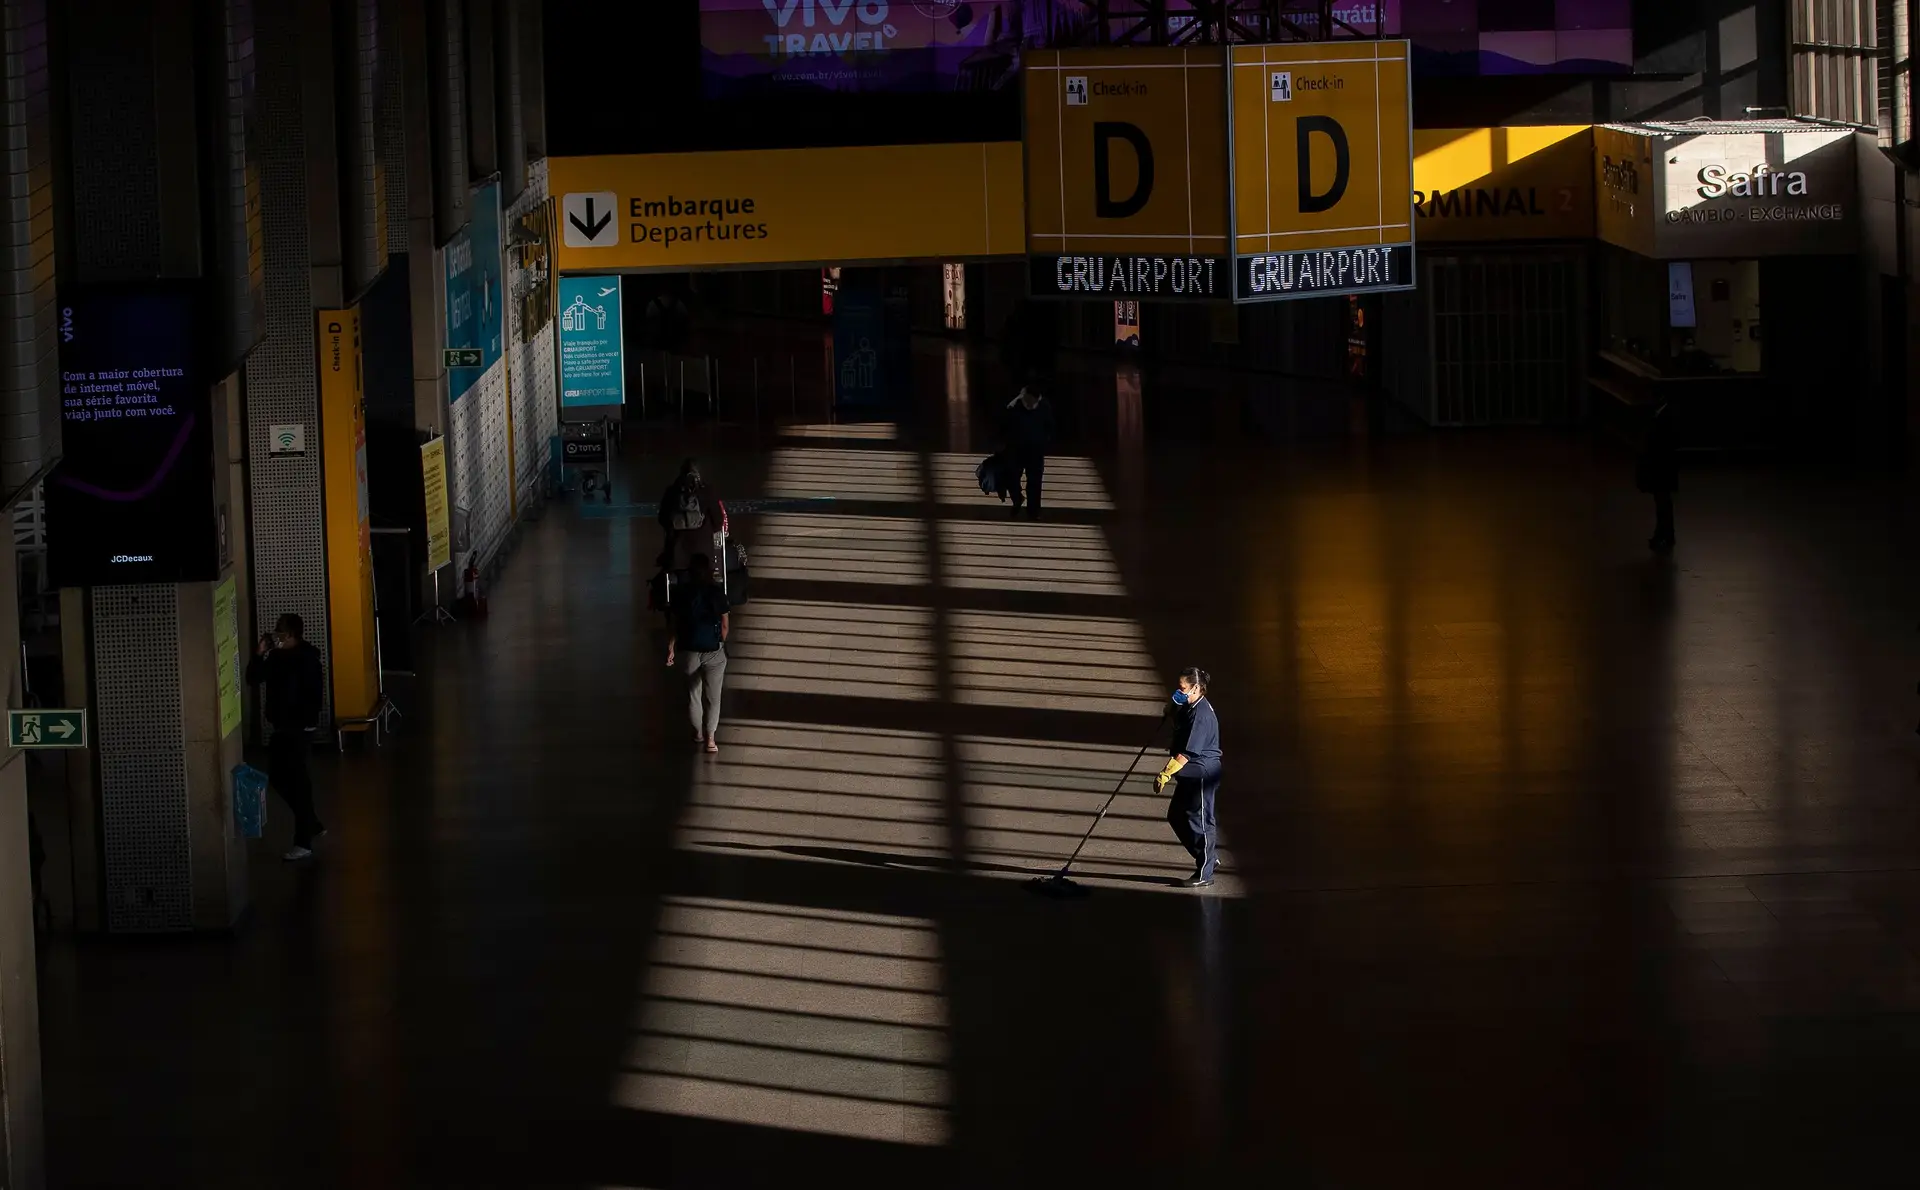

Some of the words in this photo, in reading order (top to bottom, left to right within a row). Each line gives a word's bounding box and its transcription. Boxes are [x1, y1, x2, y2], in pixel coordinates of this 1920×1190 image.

[763, 31, 890, 58] TRAVEL
[1093, 80, 1148, 96] Check-in
[1296, 74, 1344, 91] Check-in
[1094, 121, 1154, 218] D
[1296, 115, 1350, 214] D
[1698, 163, 1808, 199] Safra
[630, 196, 755, 221] Embarque
[1558, 189, 1574, 211] 2
[1750, 204, 1844, 221] EXCHANGE
[631, 220, 768, 248] Departures
[59, 305, 74, 343] vivo
[329, 322, 342, 333] D
[330, 335, 340, 372] Check-in
[63, 371, 86, 382] Com
[89, 372, 95, 380] a
[98, 368, 129, 380] maior
[133, 366, 184, 378] cobertura
[63, 382, 77, 394] de
[80, 380, 124, 393] internet
[126, 379, 160, 392] móvel,
[64, 398, 83, 407] sua
[85, 394, 112, 406] série
[115, 392, 158, 405] favorita
[65, 409, 91, 422] viaja
[93, 407, 122, 421] junto
[125, 407, 146, 417] com
[149, 404, 176, 416] você.
[578, 444, 601, 452] TOTVS
[111, 554, 154, 563] JCDecaux
